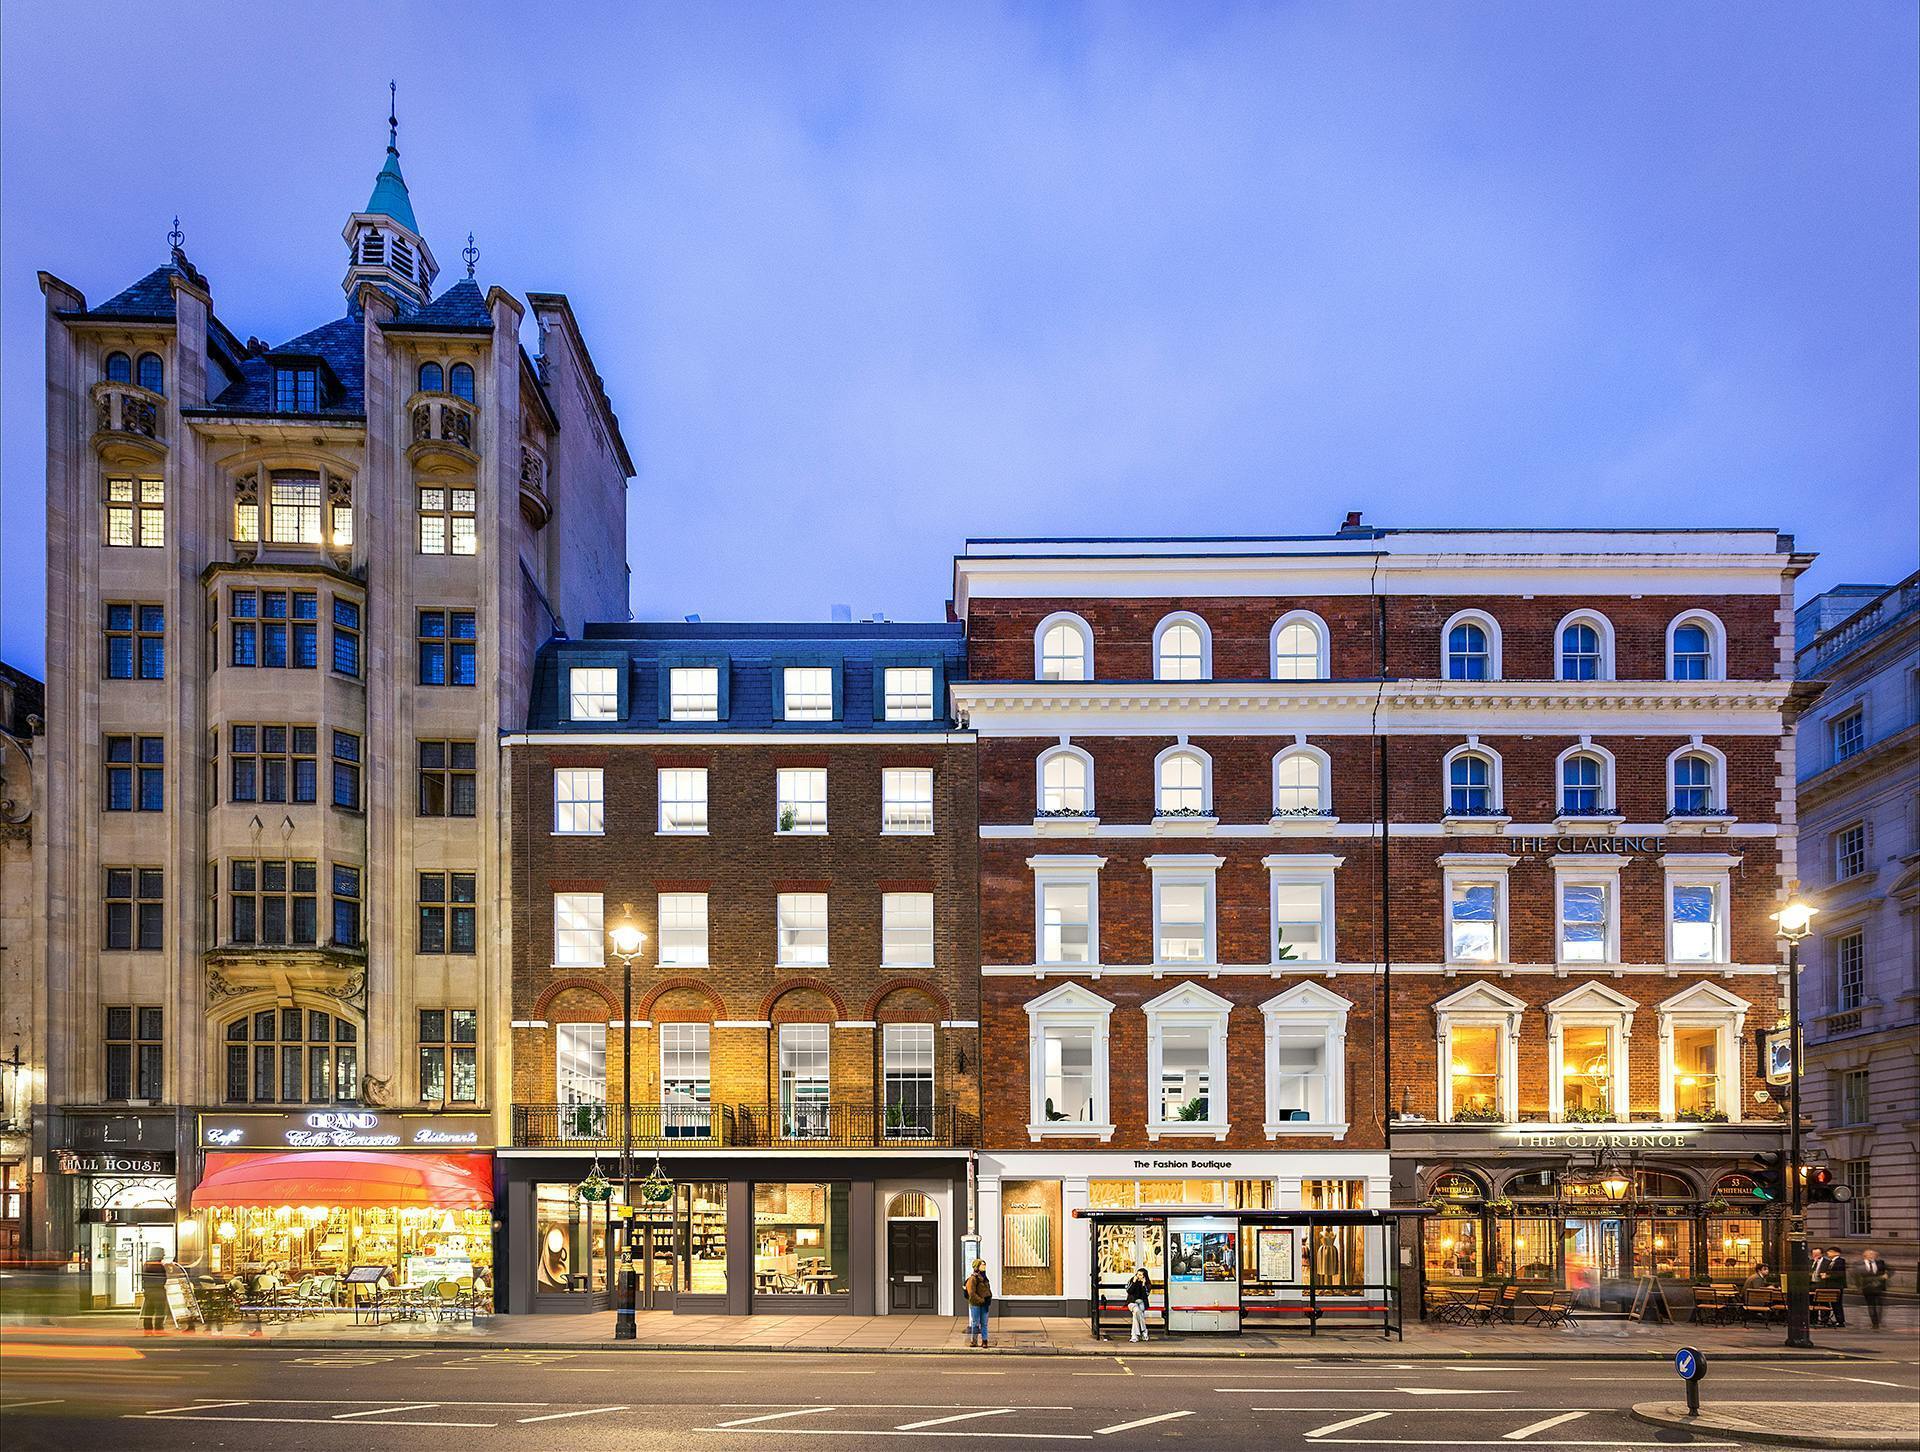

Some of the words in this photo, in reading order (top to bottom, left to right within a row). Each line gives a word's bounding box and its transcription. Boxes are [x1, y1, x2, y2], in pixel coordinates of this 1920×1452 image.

[1510, 836, 1549, 853] THE
[1556, 836, 1668, 853] CLARENCE
[306, 1112, 378, 1129] GRAND
[1514, 1134, 1557, 1147] THE
[1565, 1134, 1686, 1148] CLARENCE
[104, 1158, 161, 1172] HOUSE
[589, 1162, 640, 1172] COFEE
[1133, 1160, 1150, 1169] The
[1153, 1160, 1188, 1169] Fashion
[1191, 1160, 1232, 1170] Boutique
[1730, 1179, 1740, 1187] 53
